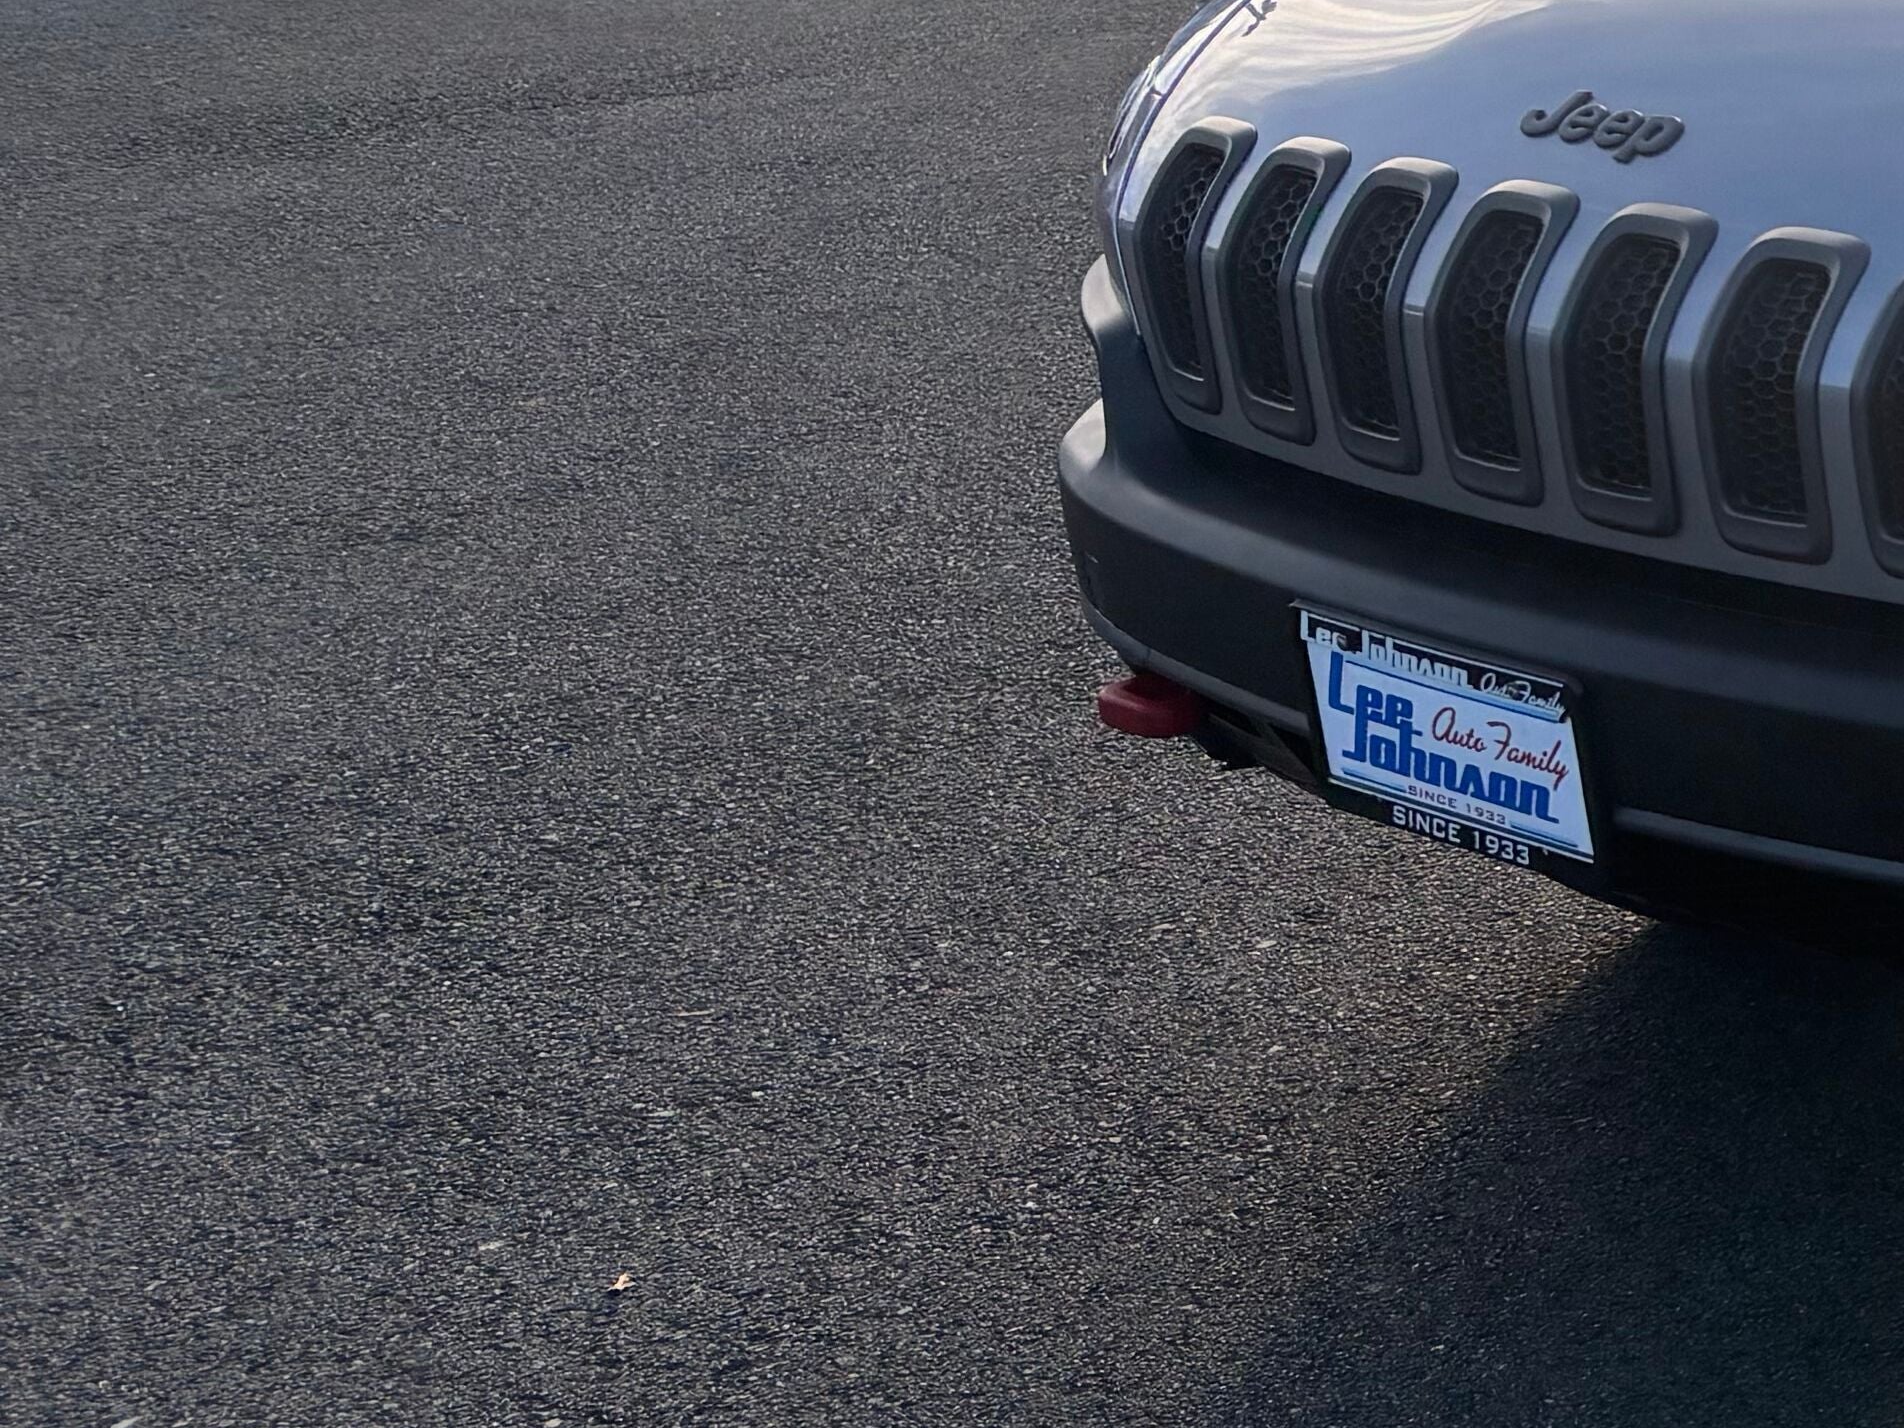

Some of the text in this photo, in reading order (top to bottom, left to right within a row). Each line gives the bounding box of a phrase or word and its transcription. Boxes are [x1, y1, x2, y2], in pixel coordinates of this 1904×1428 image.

[1519, 88, 1686, 165] Jeep
[1353, 629, 1475, 690] Johnson
[1327, 651, 1568, 791] Lee Auto Family
[1341, 702, 1560, 824] Johnson
[1392, 805, 1530, 865] SINCE 1933
[1407, 784, 1507, 826] SINCE 1933
